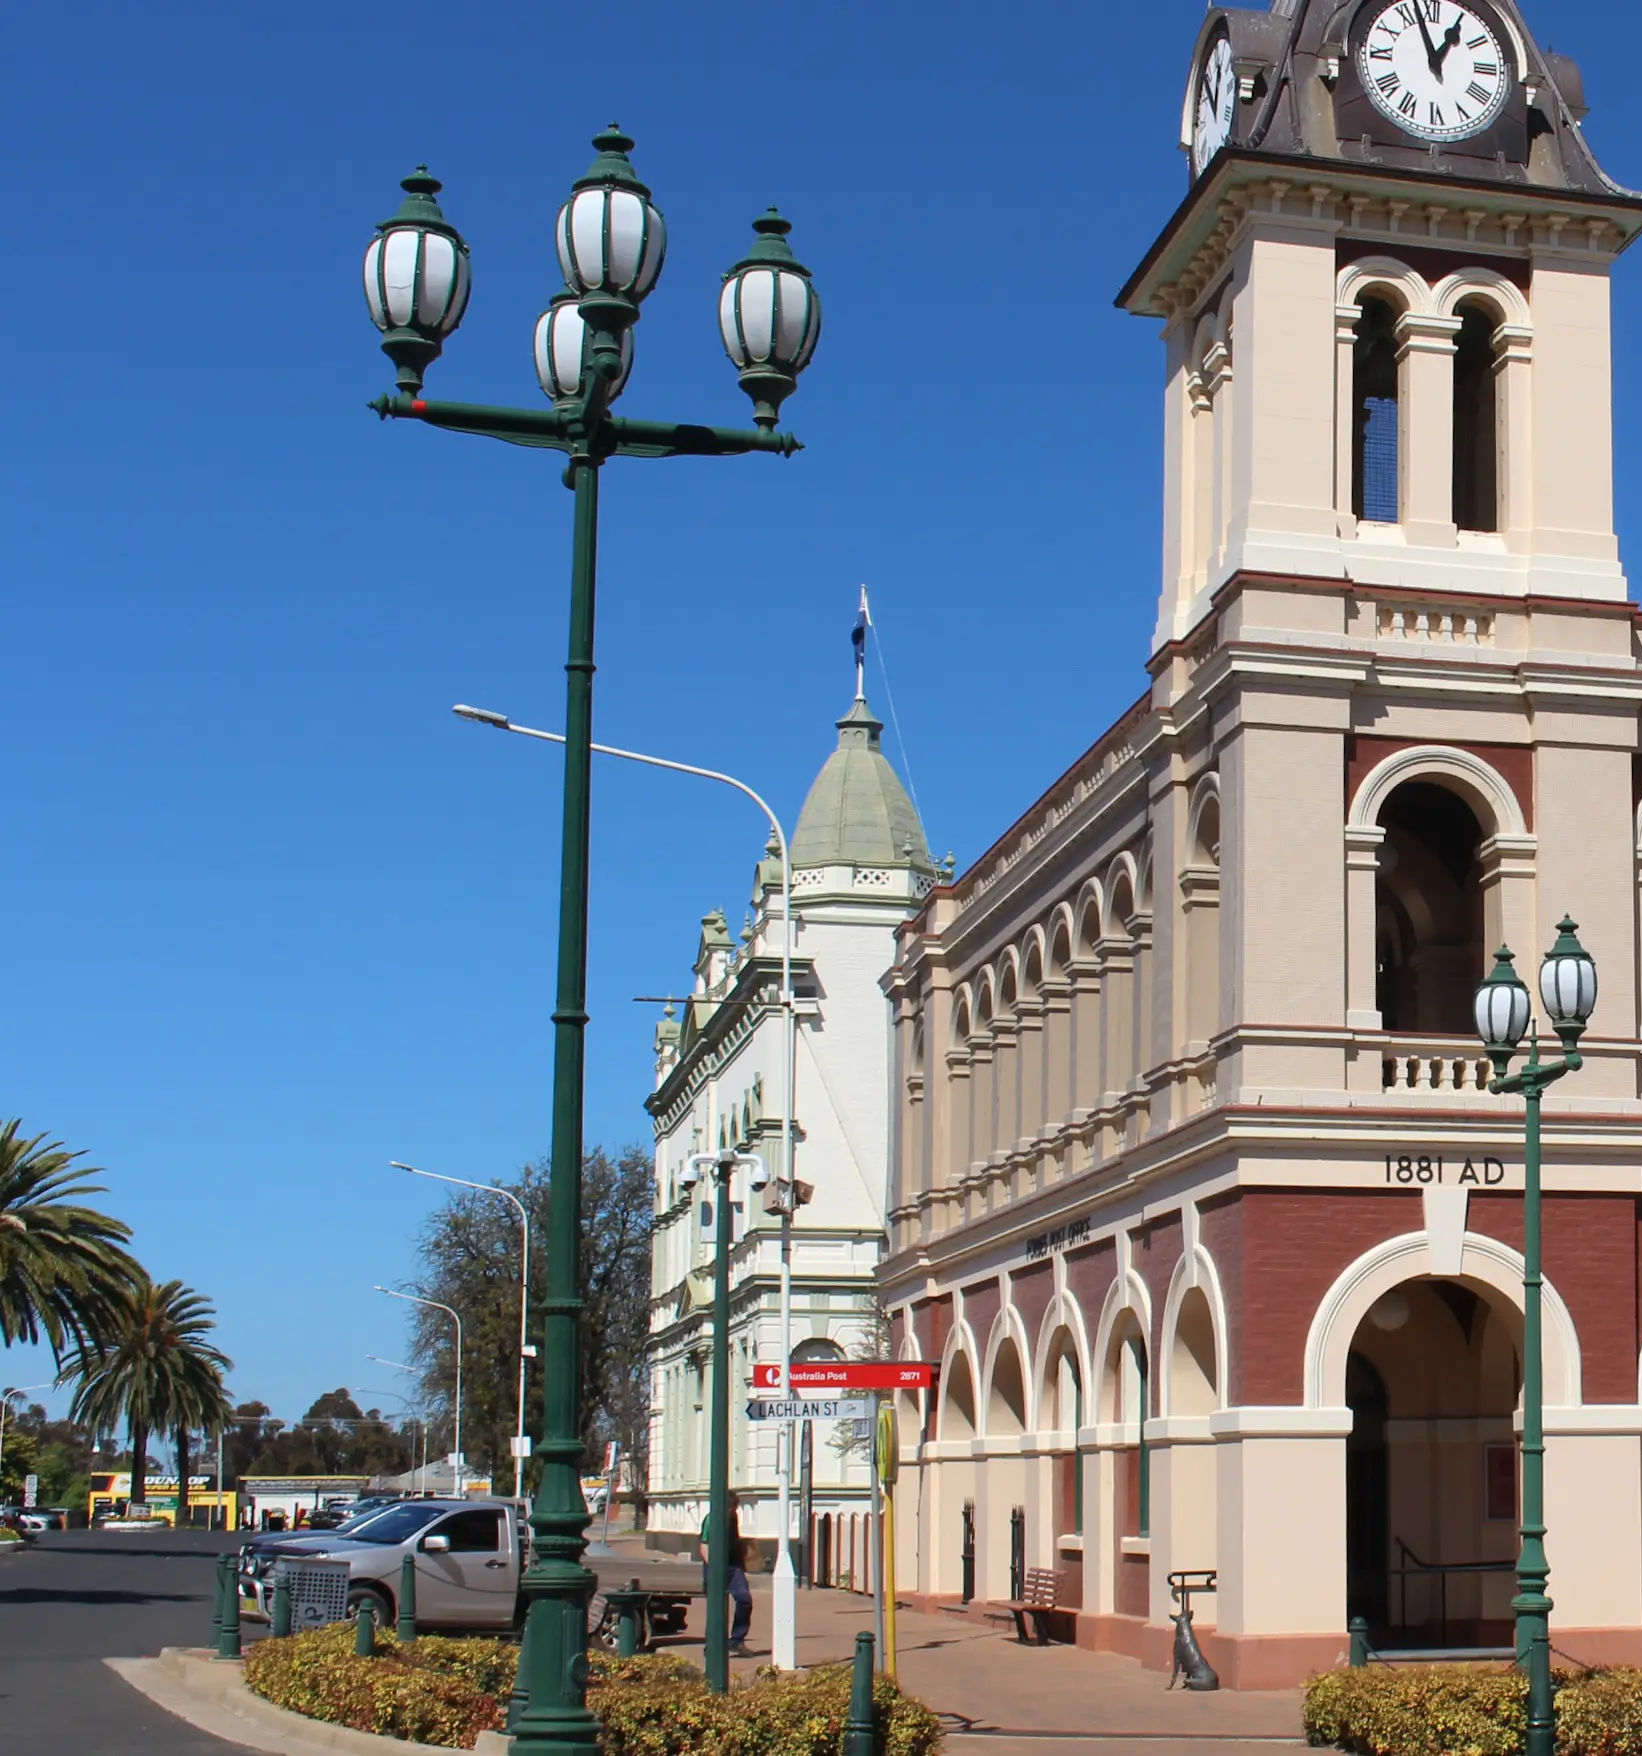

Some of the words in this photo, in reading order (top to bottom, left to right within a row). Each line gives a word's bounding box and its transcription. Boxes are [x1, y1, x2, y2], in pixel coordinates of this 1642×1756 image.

[1473, 61, 1497, 77] III
[1385, 1155, 1443, 1183] 1881
[1458, 1156, 1504, 1185] AD
[826, 1371, 847, 1381] Post
[899, 1371, 920, 1381] 2871
[758, 1402, 820, 1418] LACHLAN
[824, 1401, 839, 1416] ST
[144, 1475, 211, 1485] DUNOP
